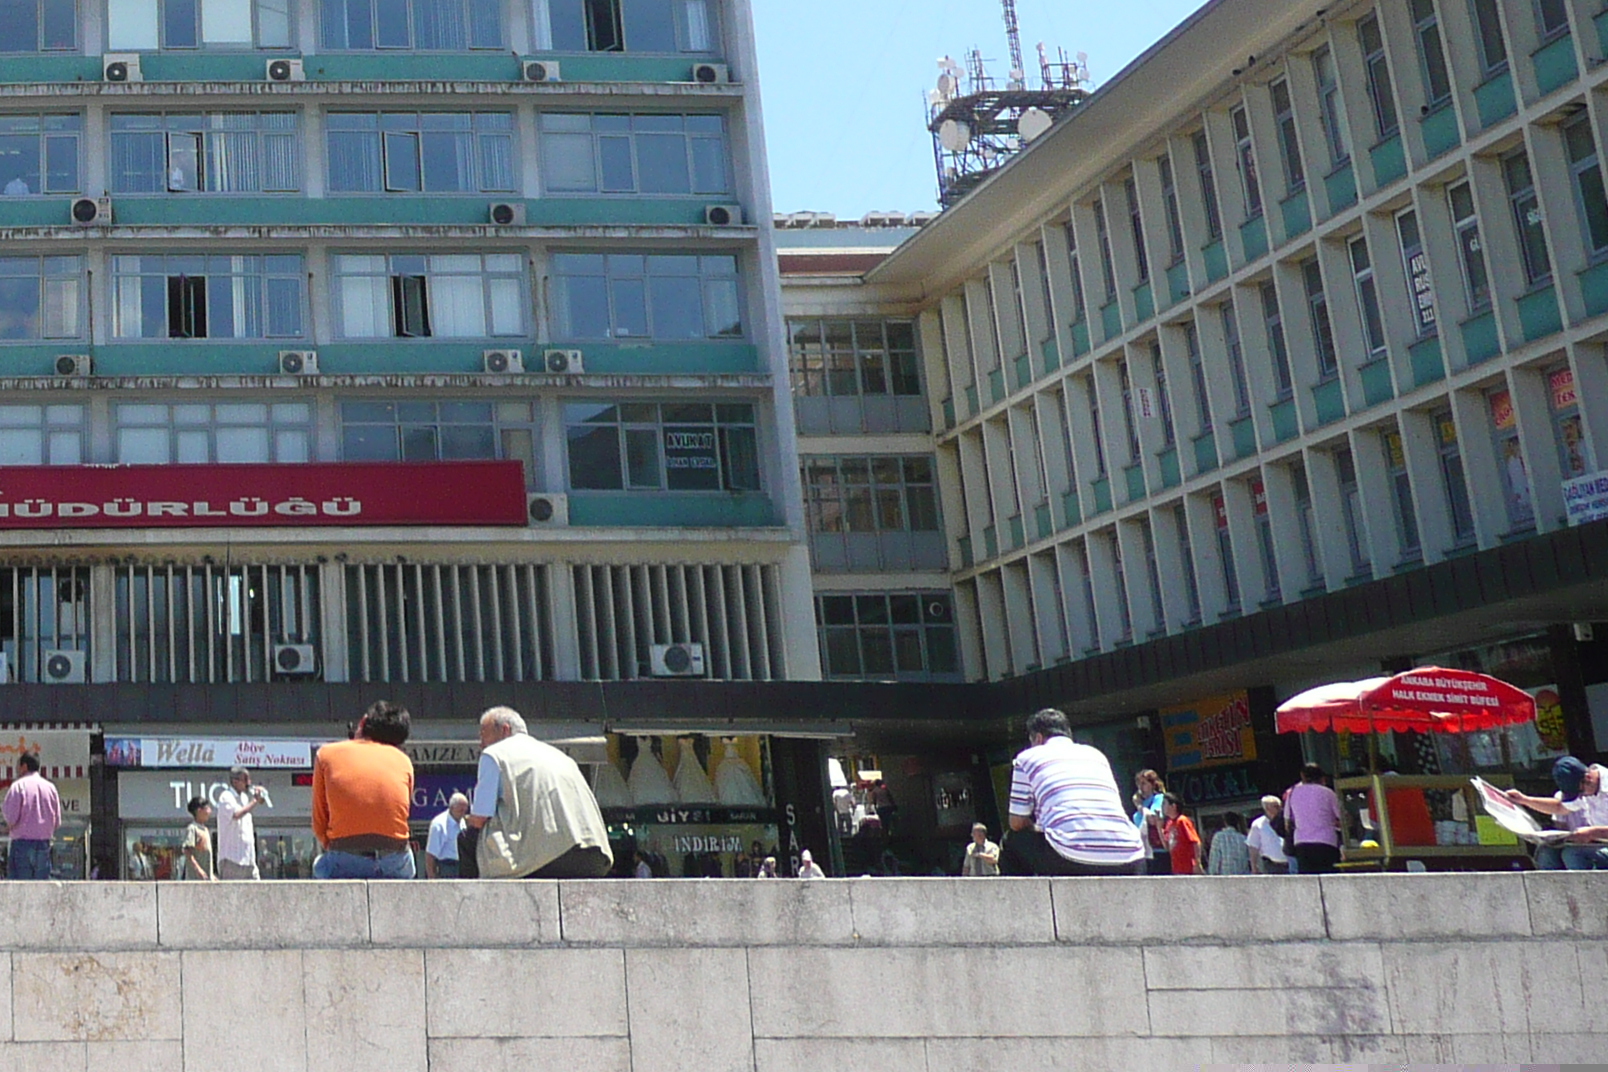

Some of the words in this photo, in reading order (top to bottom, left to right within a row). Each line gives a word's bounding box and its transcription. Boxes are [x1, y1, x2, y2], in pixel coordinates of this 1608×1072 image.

[1400, 675, 1434, 687] ANKARA
[1392, 689, 1415, 701] HALK
[157, 740, 215, 763] Wella
[410, 747, 463, 761] AMZE
